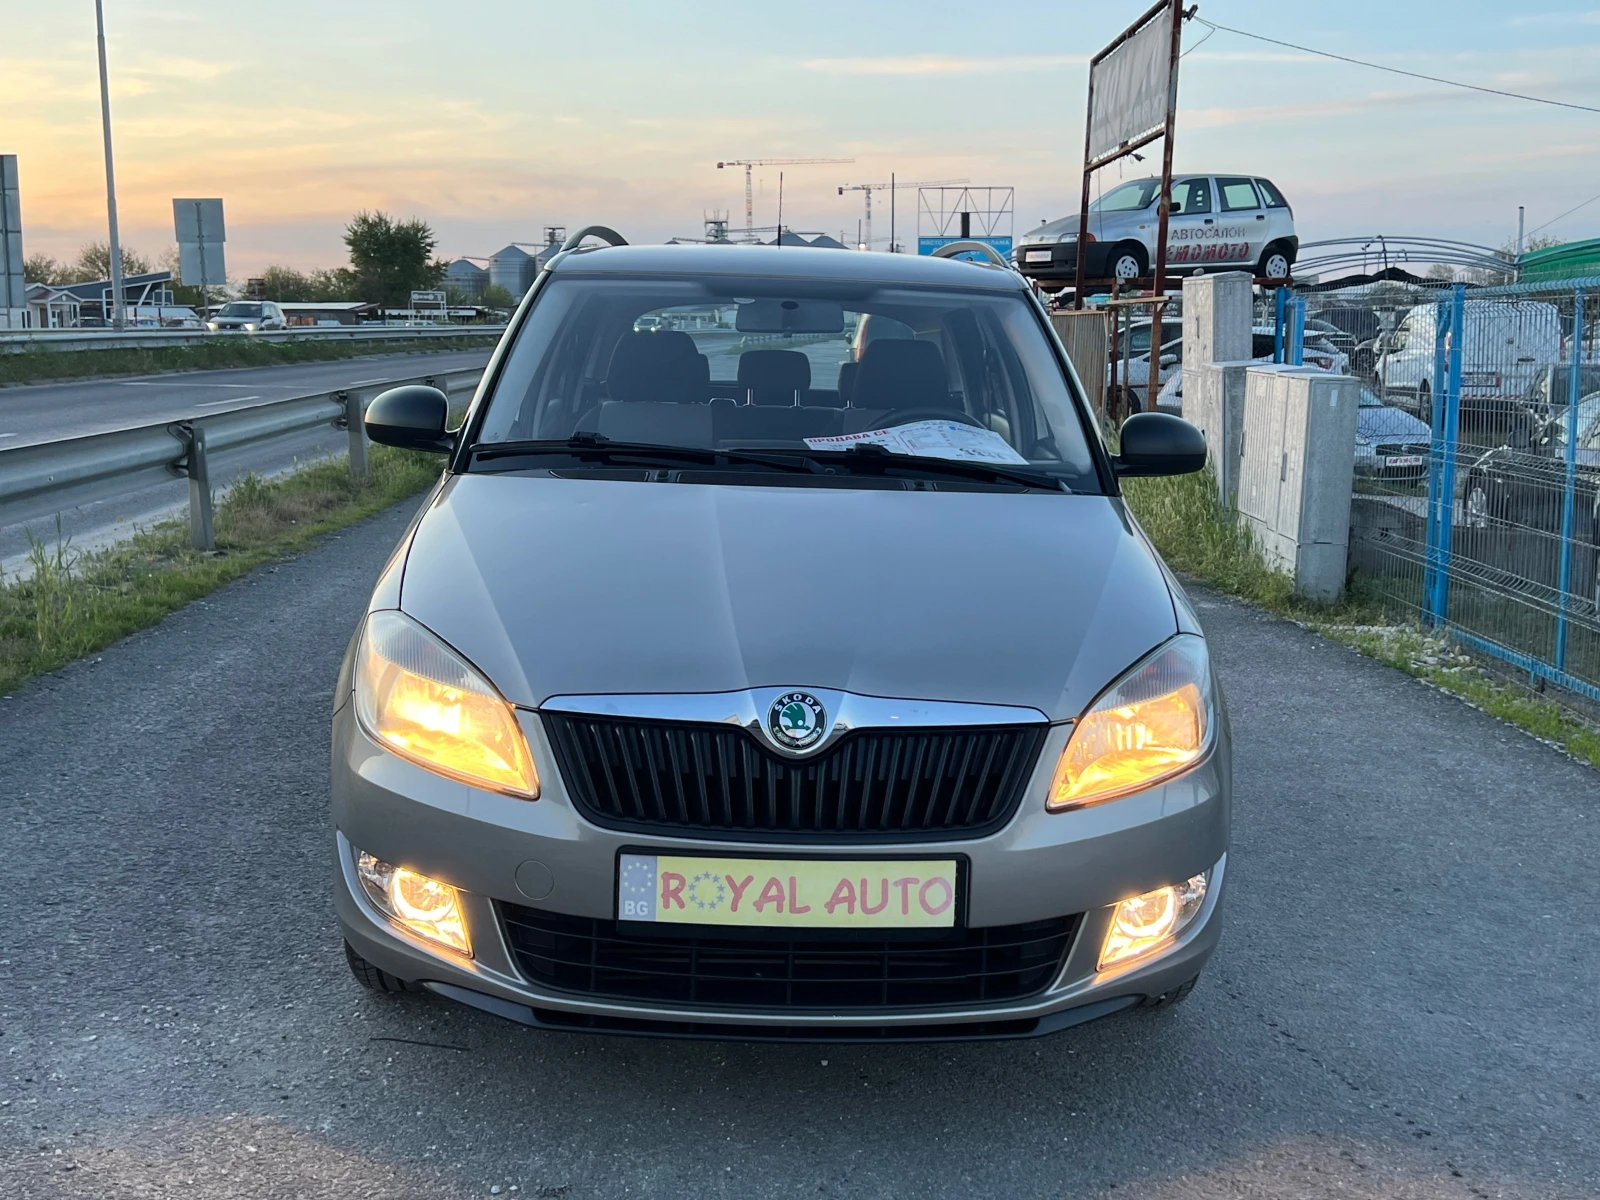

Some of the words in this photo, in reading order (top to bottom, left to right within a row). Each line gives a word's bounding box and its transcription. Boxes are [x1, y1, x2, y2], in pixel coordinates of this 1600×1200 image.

[1170, 227, 1246, 240] АВТОСАЛОН
[824, 877, 953, 915] AUTO
[624, 900, 649, 916] BG
